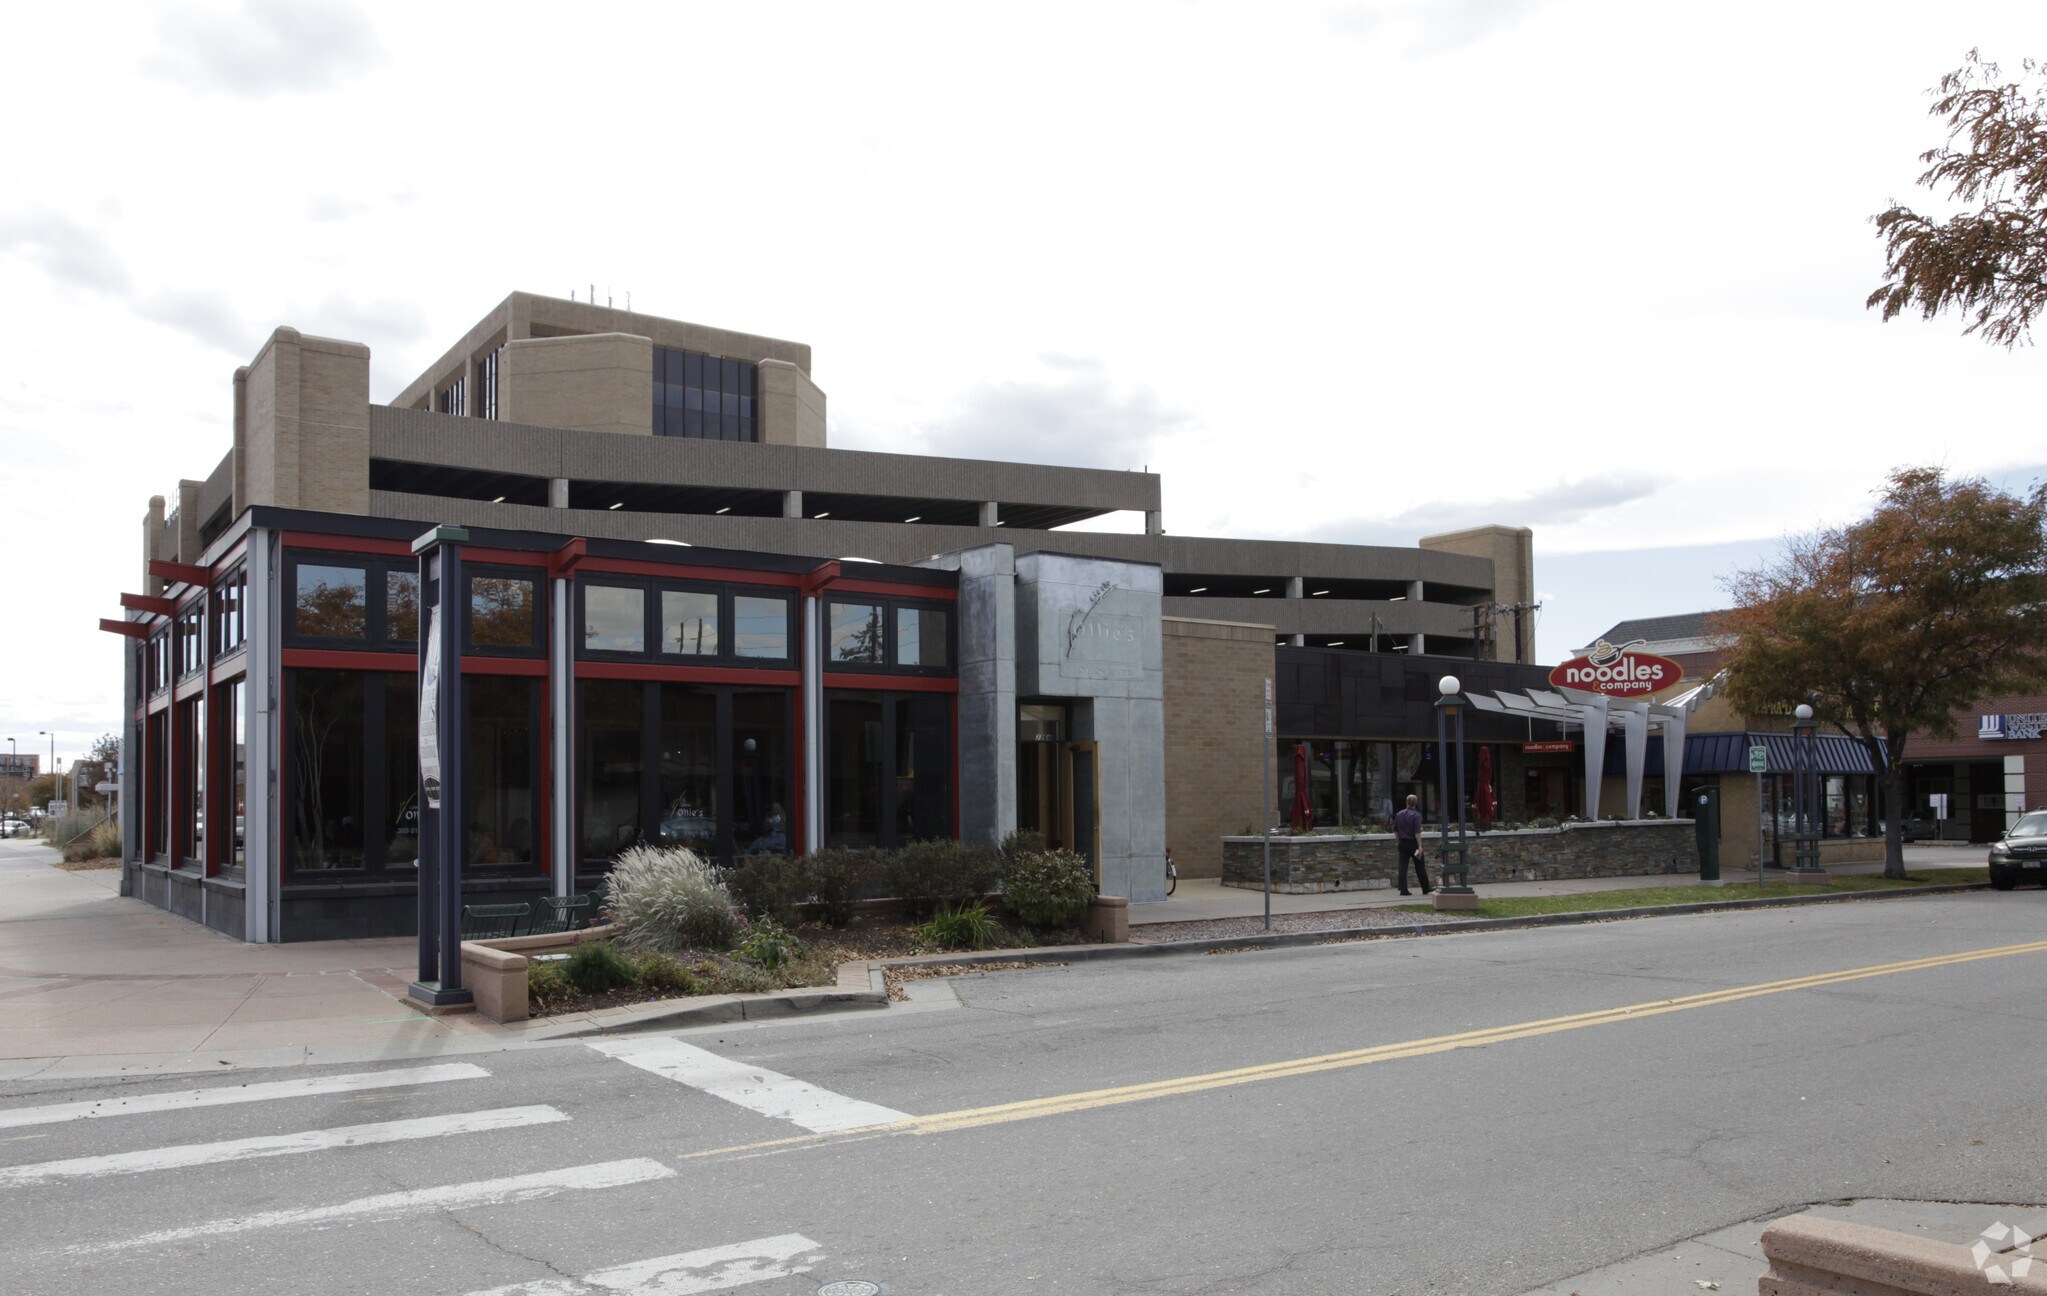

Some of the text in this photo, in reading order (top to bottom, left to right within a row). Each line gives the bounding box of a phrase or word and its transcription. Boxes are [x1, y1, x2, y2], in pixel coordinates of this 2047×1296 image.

[1072, 620, 1136, 643] Ollie's
[1566, 656, 1664, 684] noodles
[1600, 682, 1653, 693] company
[2008, 729, 2042, 739] BANK
